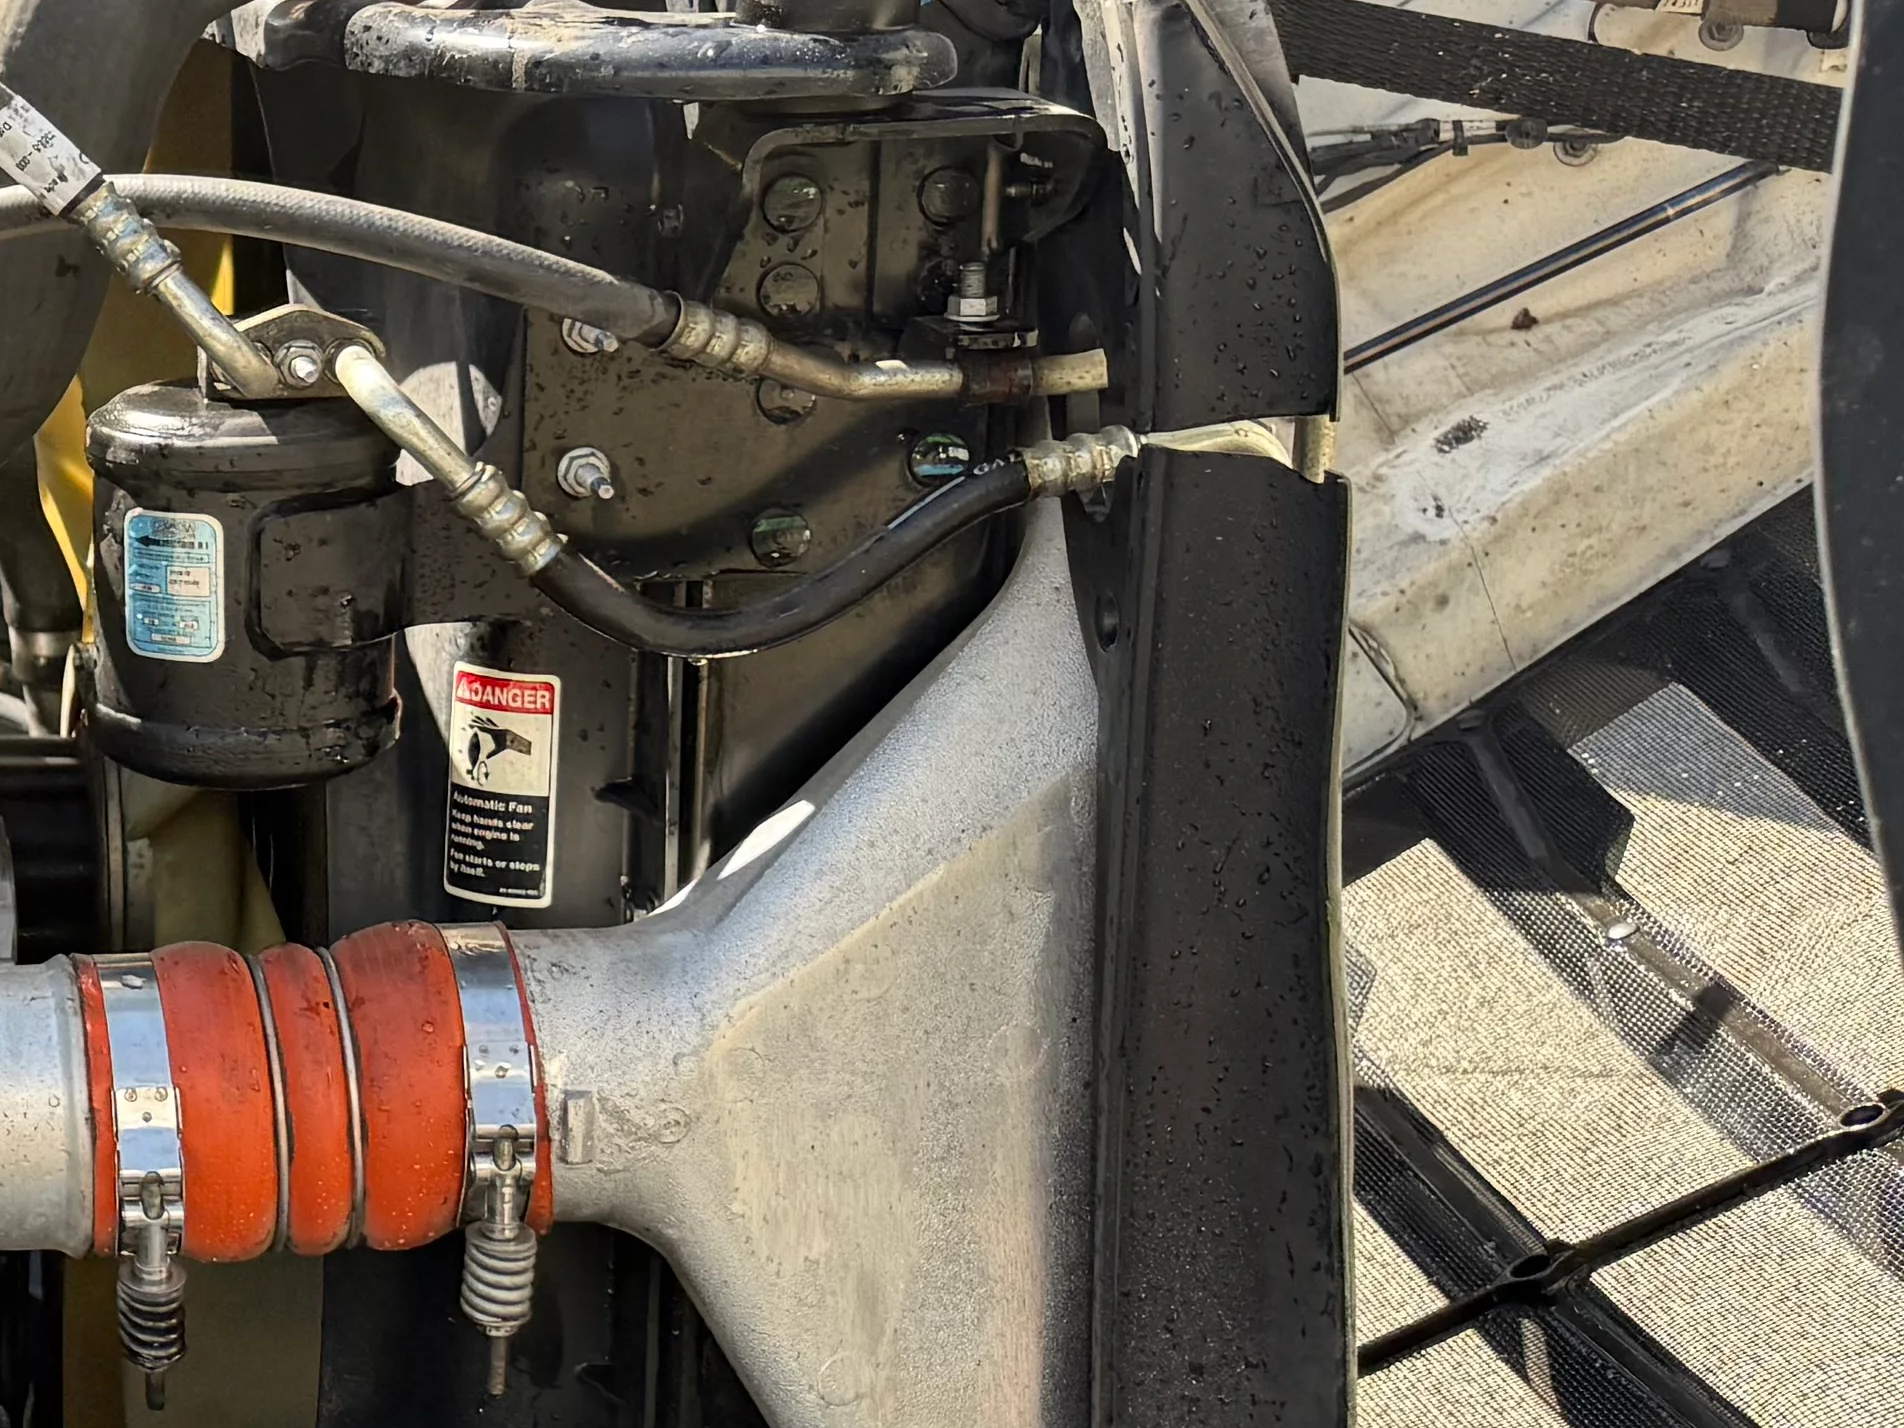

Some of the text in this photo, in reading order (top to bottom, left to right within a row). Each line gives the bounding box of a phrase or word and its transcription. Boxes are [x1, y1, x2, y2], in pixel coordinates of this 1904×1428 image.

[470, 681, 550, 709] DANGER
[454, 790, 532, 813] Automatic Fan
[473, 814, 504, 828] hands
[506, 820, 534, 830] clear
[474, 828, 507, 840] engine
[465, 854, 493, 867] starts
[495, 860, 507, 868] or
[509, 861, 540, 872] stops
